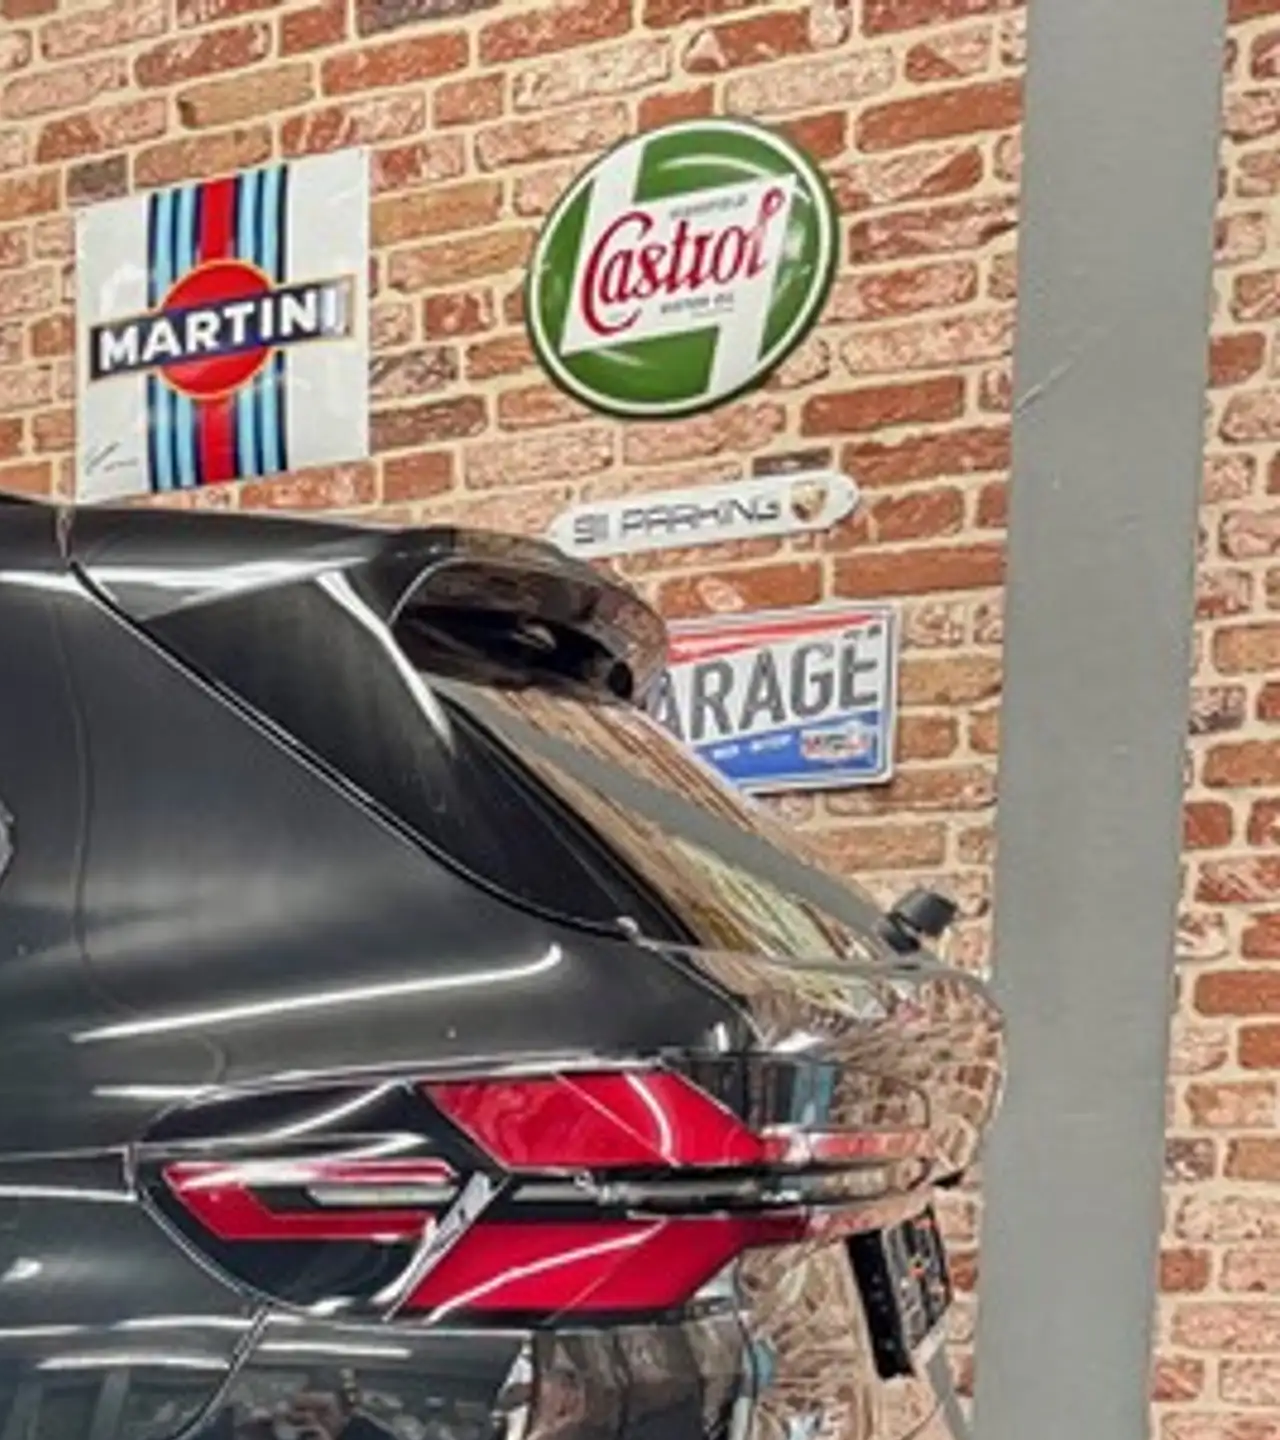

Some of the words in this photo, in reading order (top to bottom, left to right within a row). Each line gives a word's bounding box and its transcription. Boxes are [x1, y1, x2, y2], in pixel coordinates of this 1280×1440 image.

[582, 187, 786, 335] Castrol
[98, 286, 340, 372] MARTINI
[620, 496, 782, 538] PARKING
[648, 622, 883, 744] ARAGE
